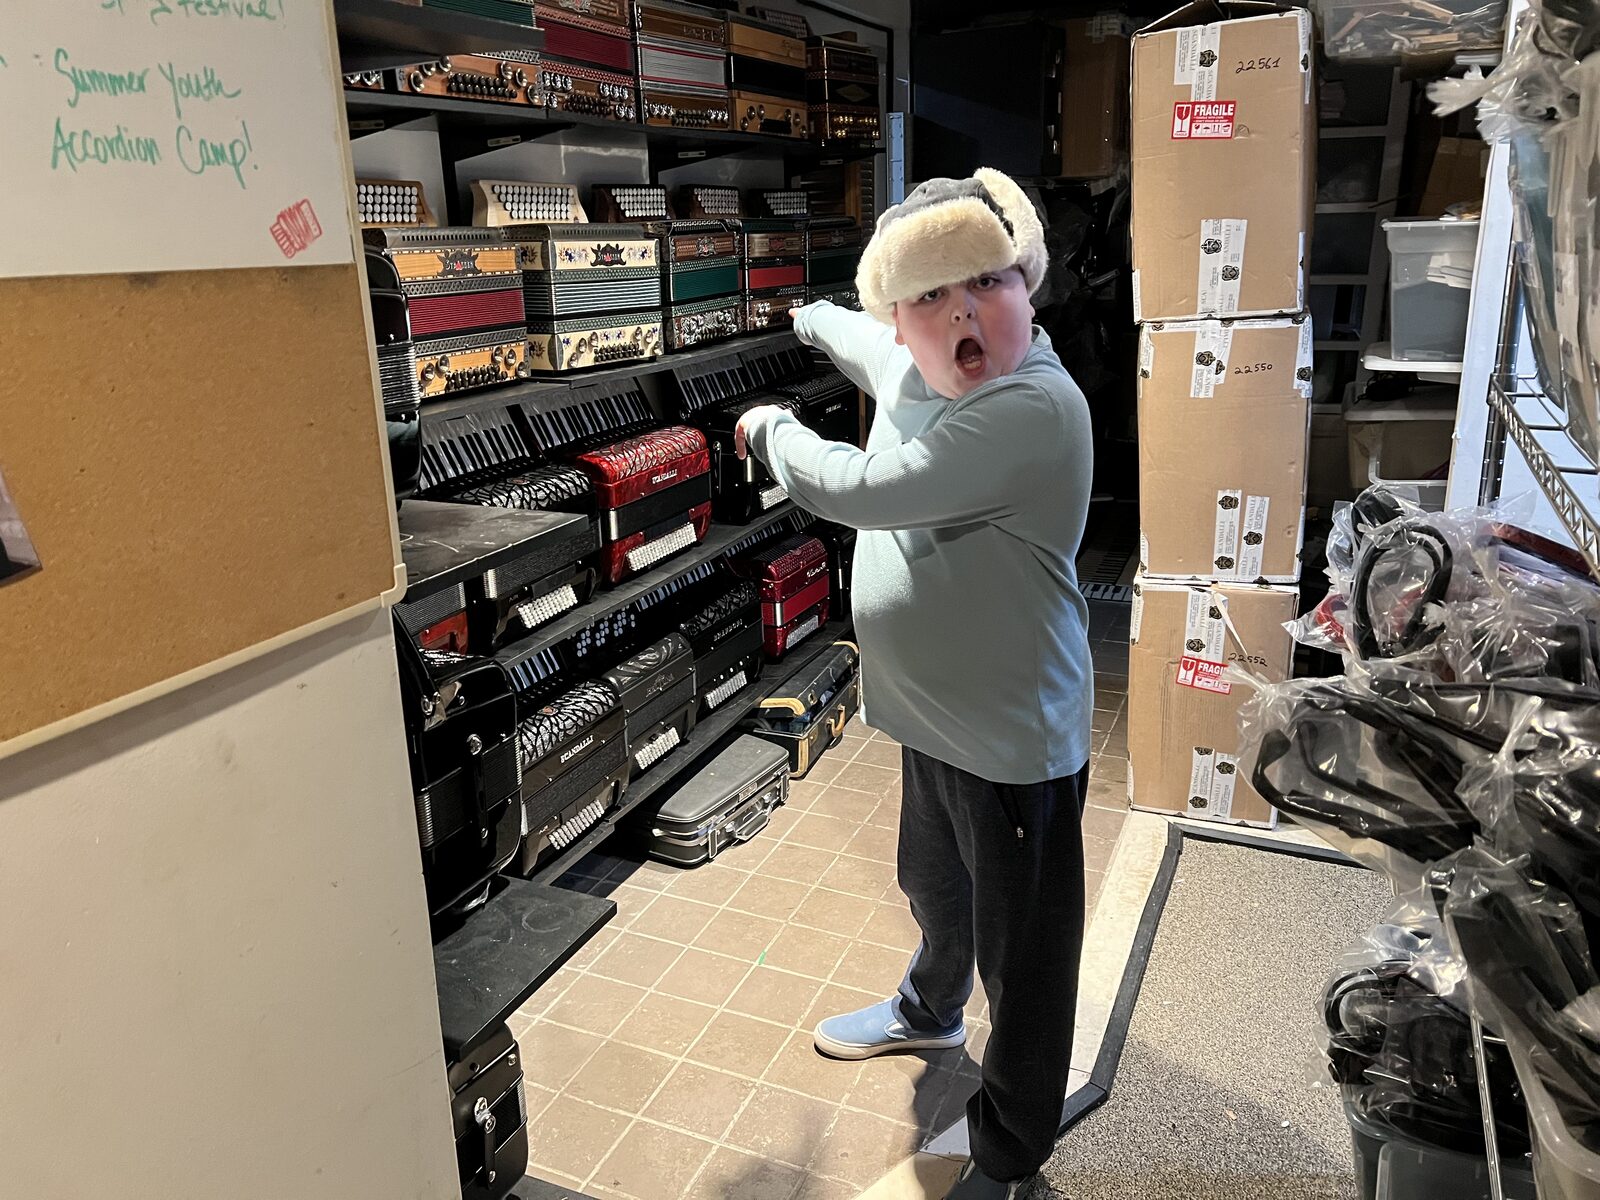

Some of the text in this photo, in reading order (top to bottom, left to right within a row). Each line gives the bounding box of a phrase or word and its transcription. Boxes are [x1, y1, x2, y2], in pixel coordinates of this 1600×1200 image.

[1235, 57, 1281, 74] 22561
[54, 47, 242, 120] Summer Youth
[1193, 104, 1235, 116] FRAGILE
[51, 116, 259, 190] Accordion Camp!
[1234, 363, 1273, 375] 22550
[1228, 652, 1268, 667] 22552
[1198, 662, 1224, 675] FRAGI
